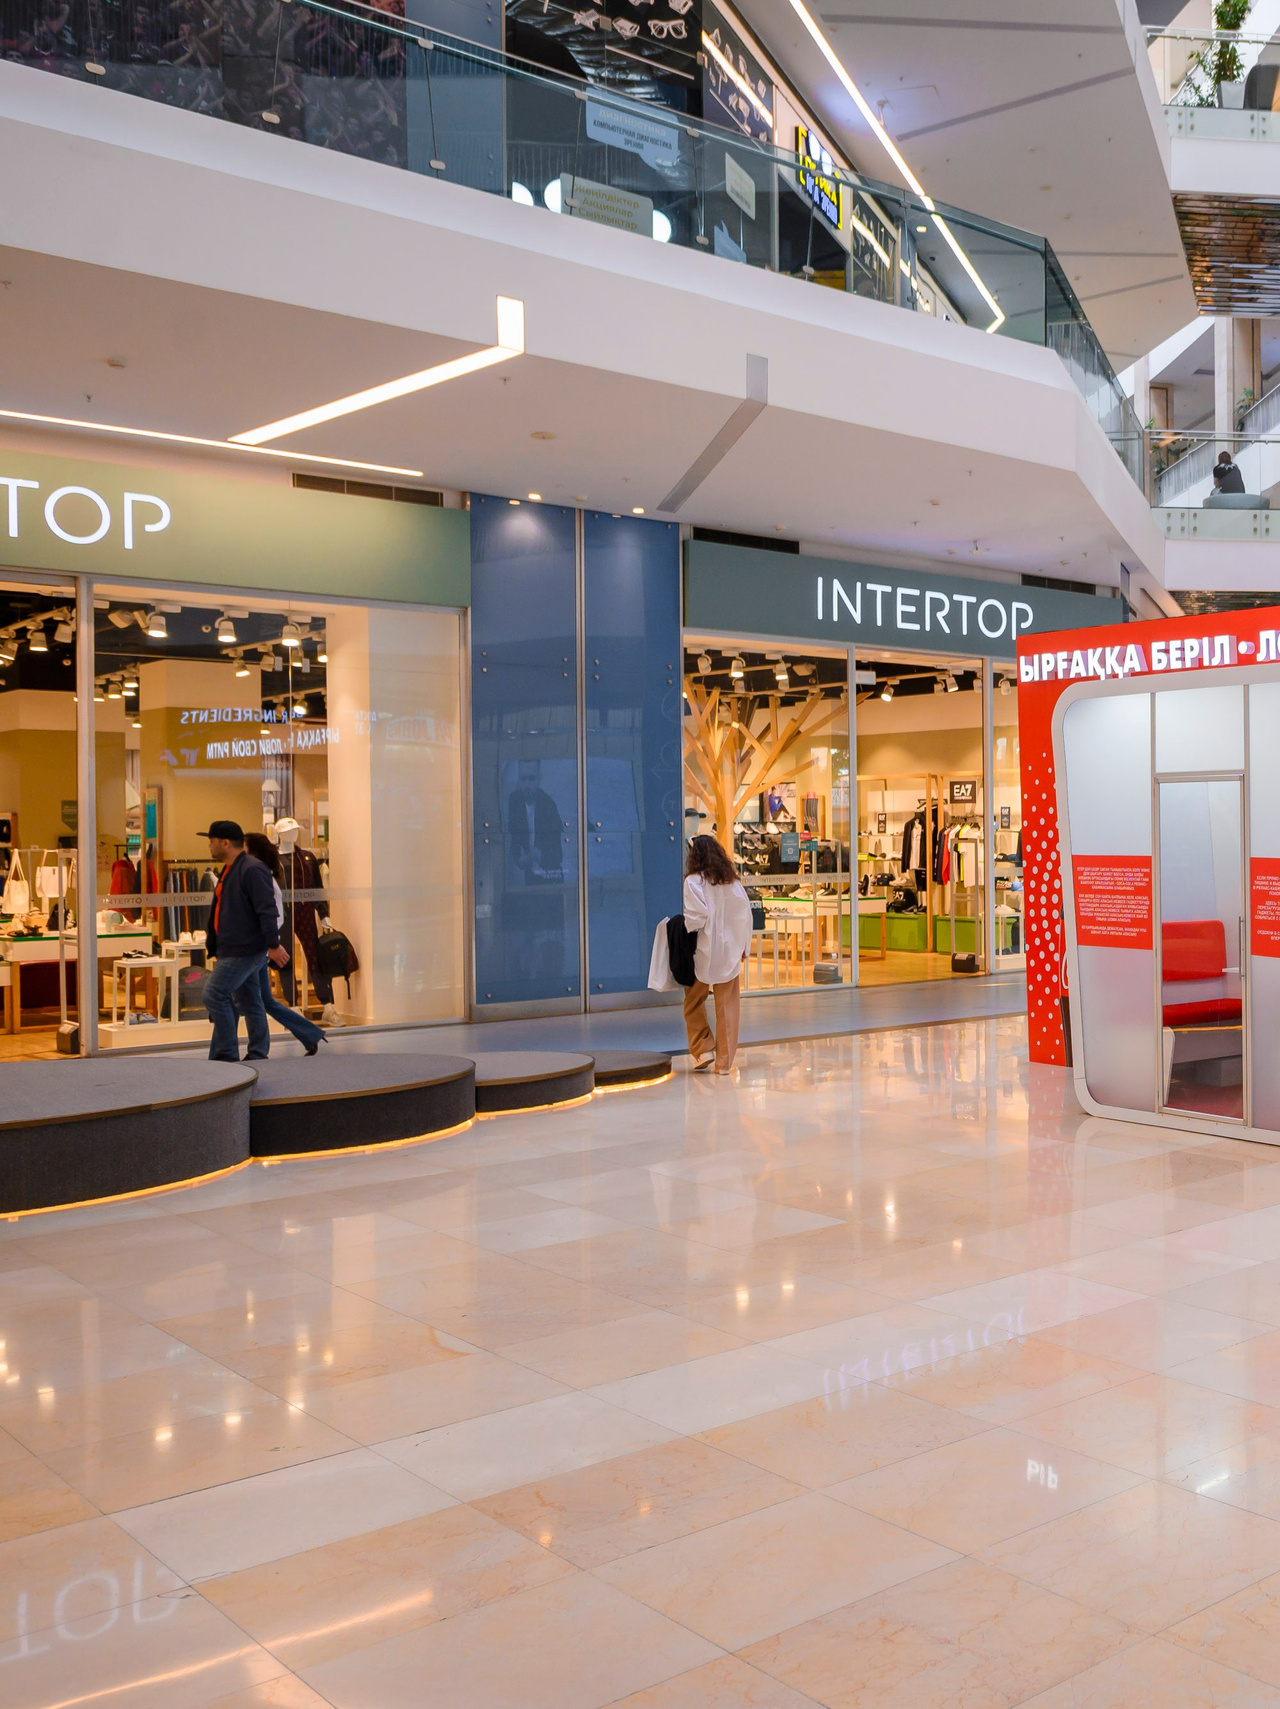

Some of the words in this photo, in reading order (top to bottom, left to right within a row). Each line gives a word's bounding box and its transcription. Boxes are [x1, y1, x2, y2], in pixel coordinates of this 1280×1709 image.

[0, 476, 171, 550] TOP
[817, 576, 1034, 641] INTERTOP
[953, 784, 972, 797] EA7
